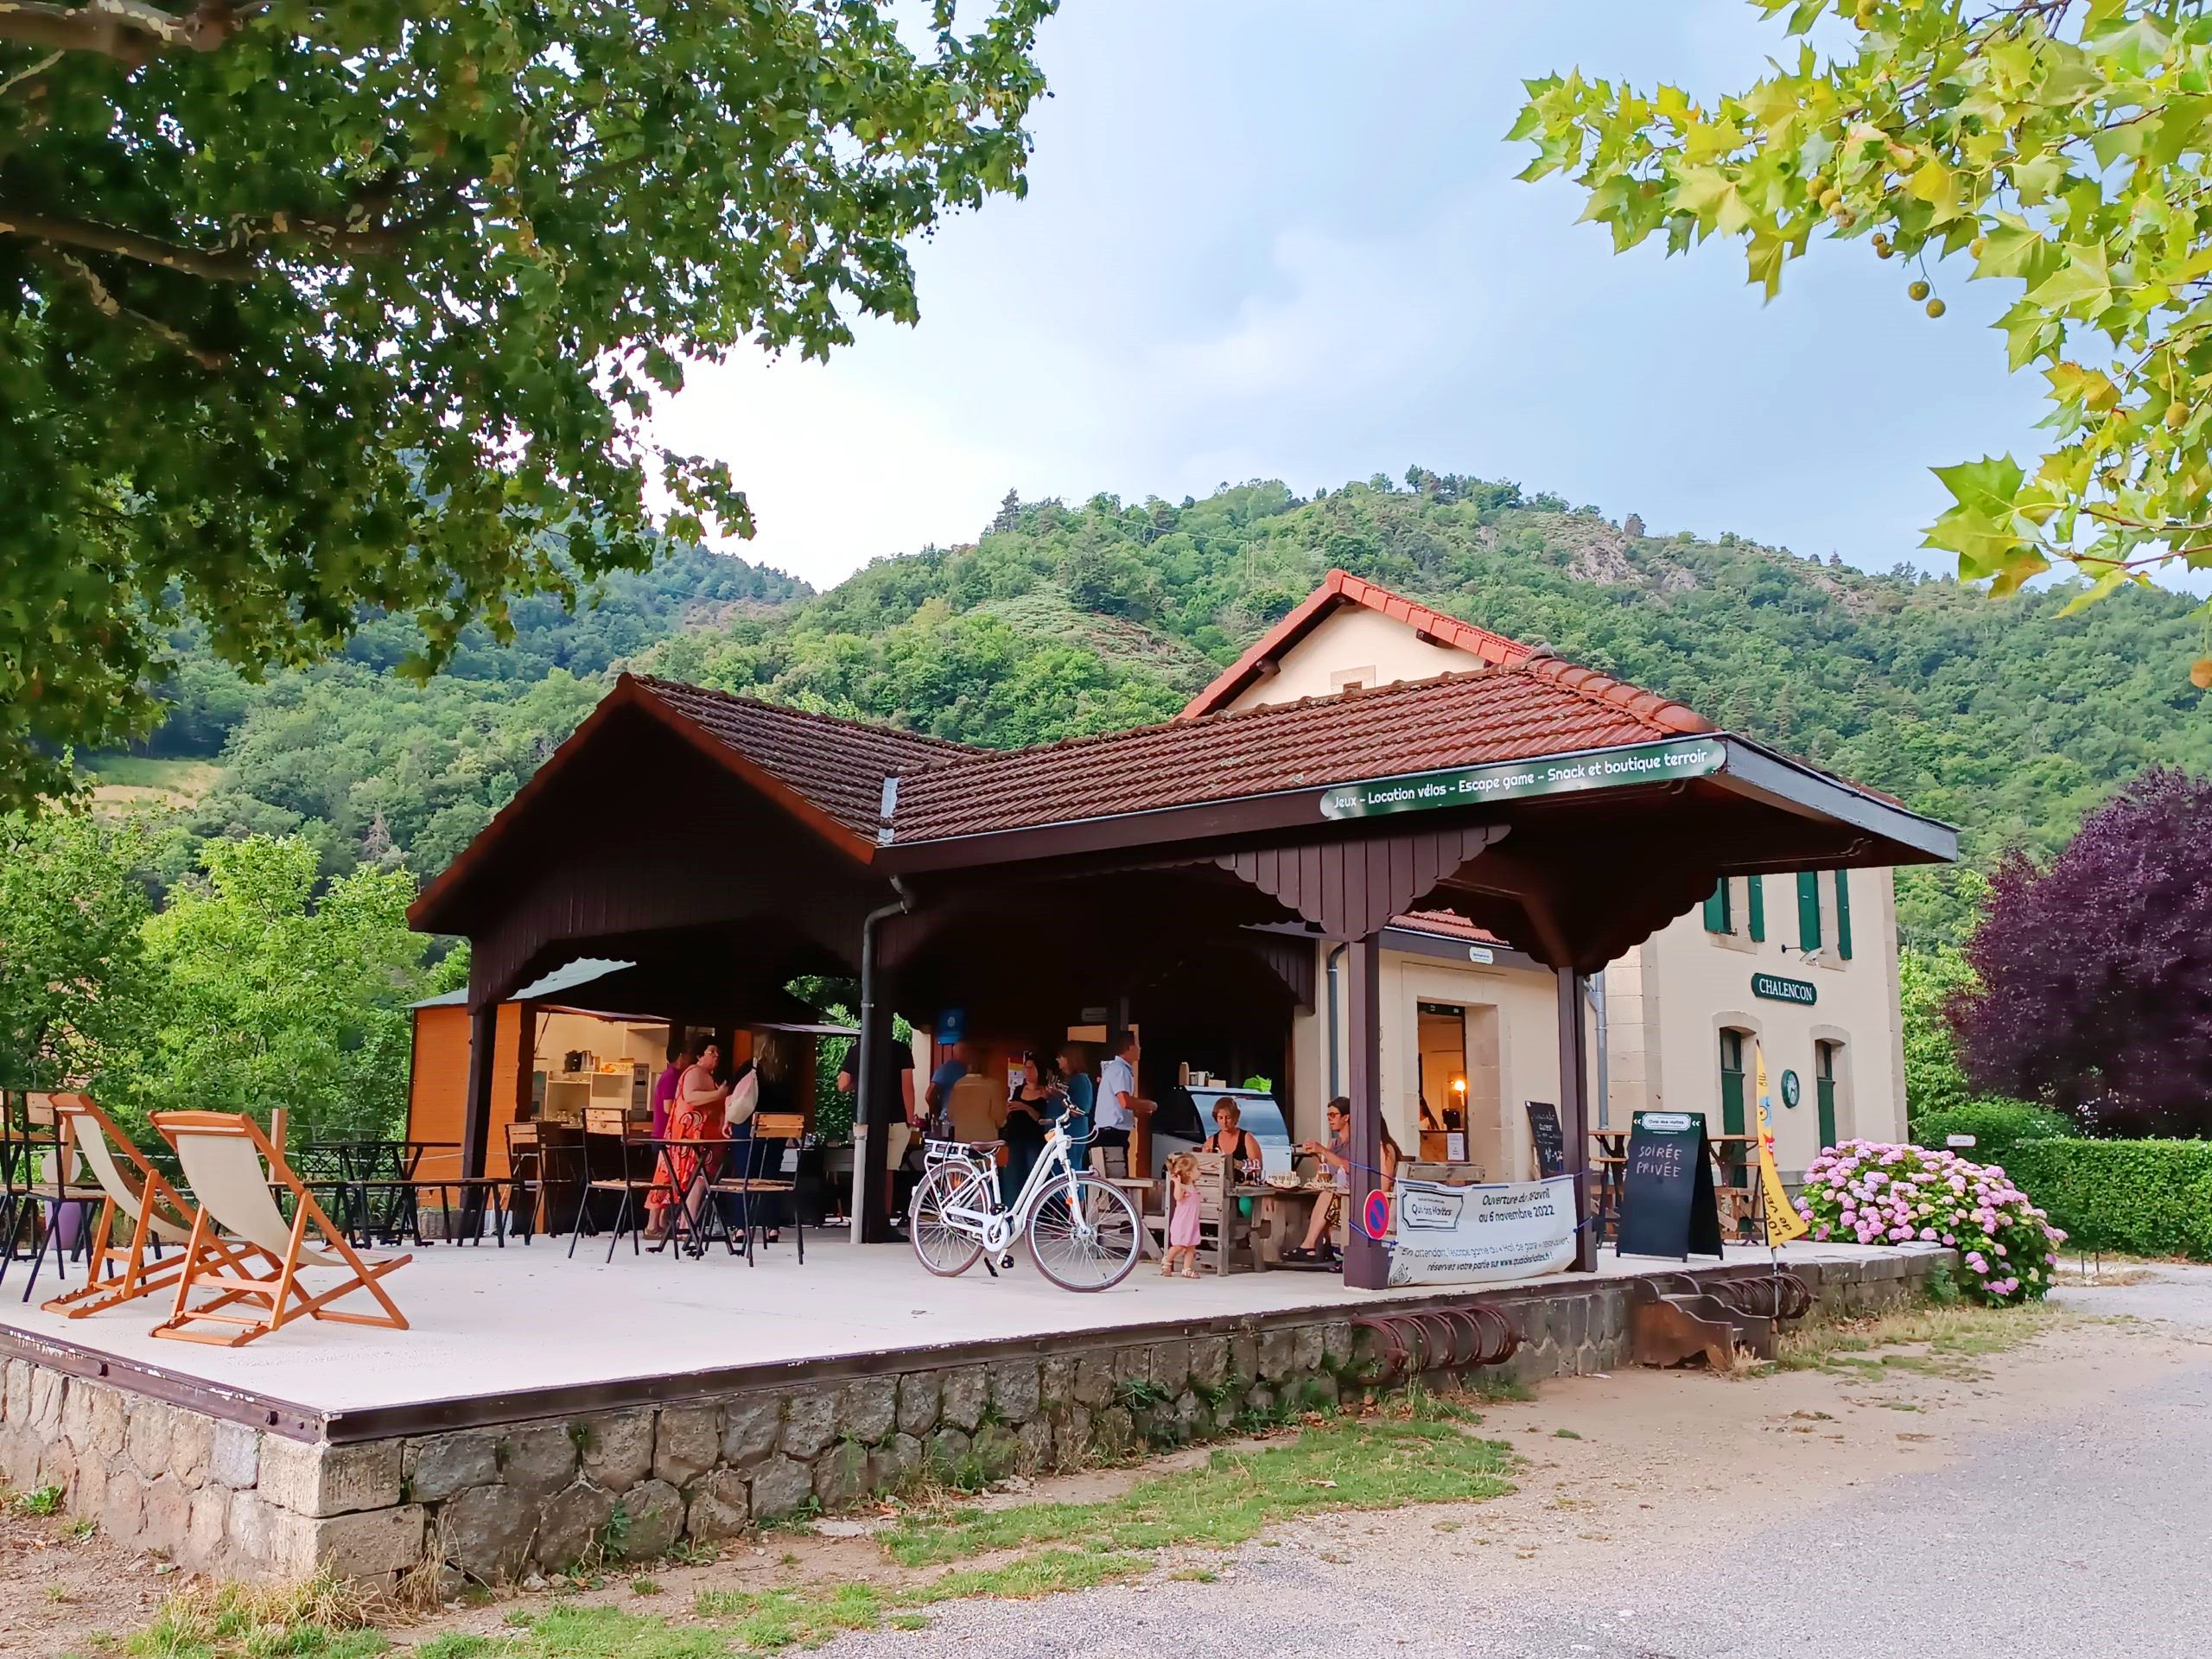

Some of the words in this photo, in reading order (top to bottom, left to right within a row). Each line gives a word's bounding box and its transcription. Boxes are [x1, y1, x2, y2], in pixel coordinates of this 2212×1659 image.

[1333, 796, 1357, 809] Jeux
[1368, 787, 1415, 804] Location
[1418, 783, 1447, 798] vélos
[1459, 778, 1500, 793] Escape
[1503, 772, 1535, 790] game
[1548, 764, 1586, 782] Snack
[1588, 762, 1602, 776] et
[1604, 757, 1662, 774] boutique
[1663, 748, 1708, 766] terroir
[1758, 978, 1813, 1001] CHALENCON
[1638, 1143, 1683, 1160] SOIRÉE
[1636, 1161, 1682, 1178] PRIVÉE
[1482, 1194, 1518, 1205] Ouverture
[1478, 1213, 1488, 1223] au
[1489, 1211, 1494, 1222] 6
[1495, 1208, 1533, 1222] novembre
[1533, 1205, 1555, 1217] 2022
[1779, 1217, 1792, 1230] de
